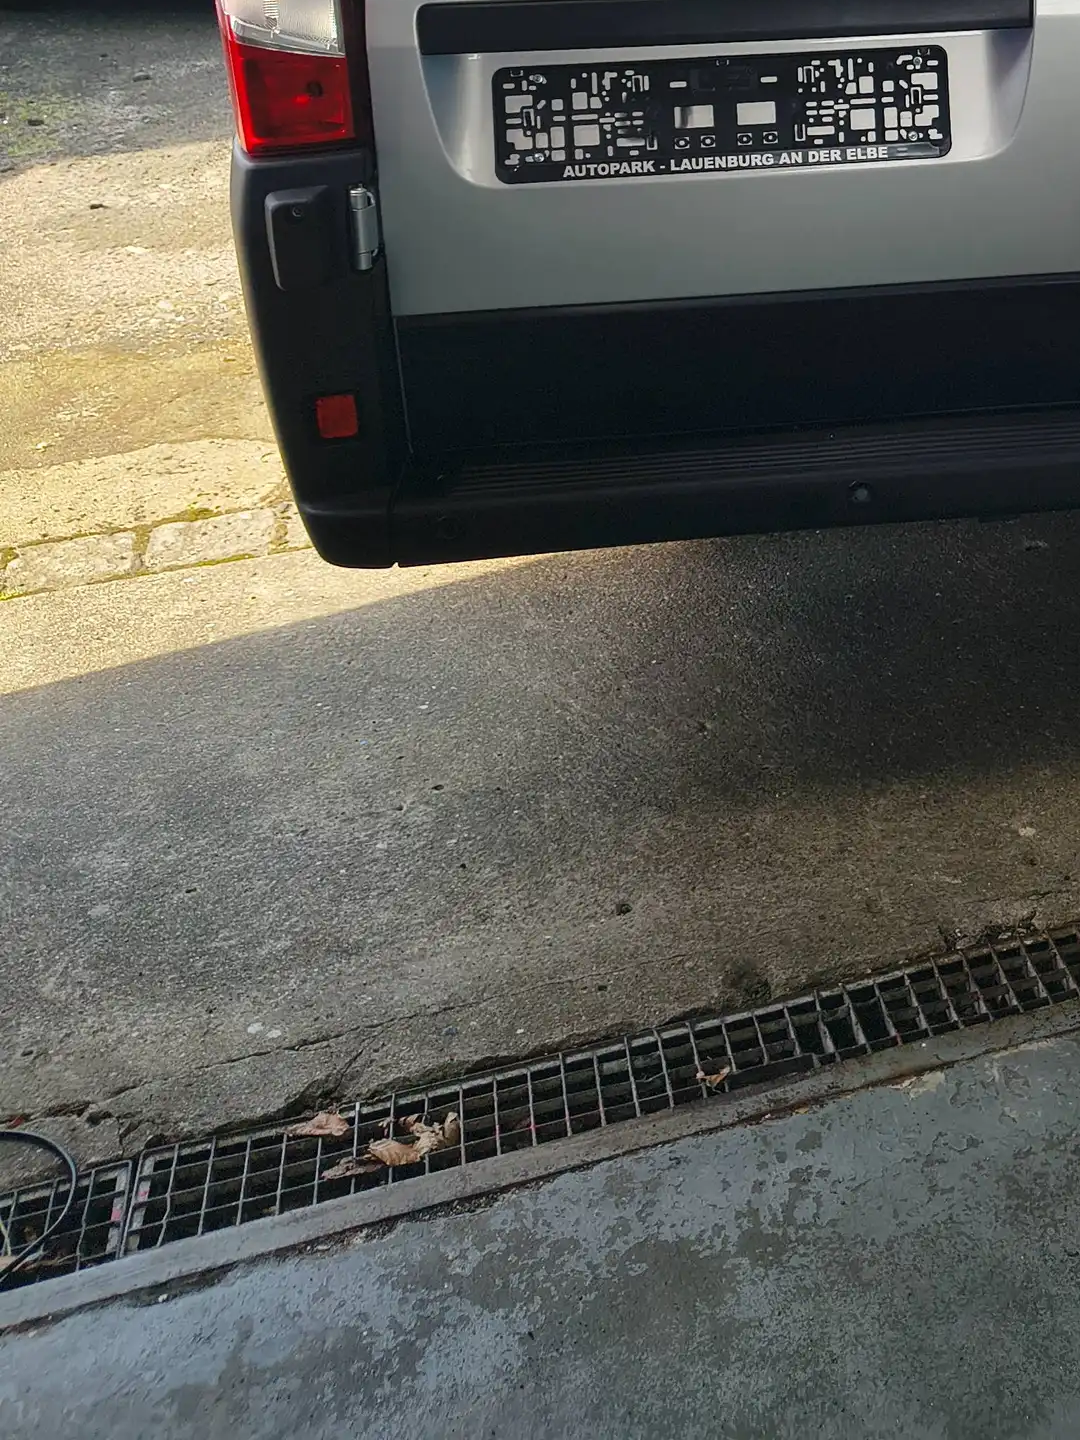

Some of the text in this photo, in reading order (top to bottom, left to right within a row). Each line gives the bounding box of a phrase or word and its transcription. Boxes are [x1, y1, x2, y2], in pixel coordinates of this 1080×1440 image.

[563, 160, 656, 178] AUTOPARK
[670, 153, 774, 172] LAUENBURG
[778, 151, 803, 165] AN
[808, 149, 842, 163] DER
[846, 146, 888, 161] ELBE
